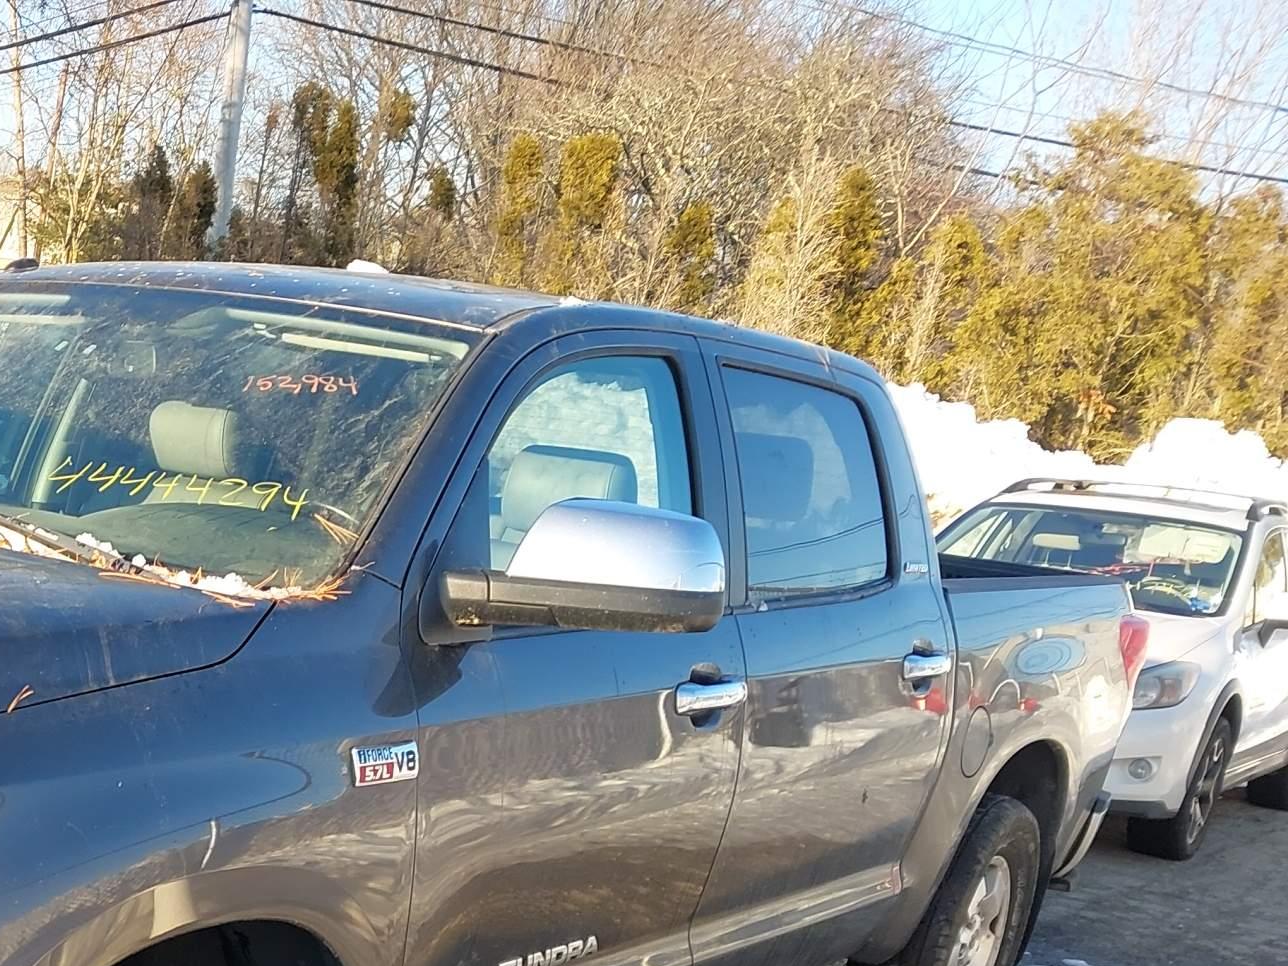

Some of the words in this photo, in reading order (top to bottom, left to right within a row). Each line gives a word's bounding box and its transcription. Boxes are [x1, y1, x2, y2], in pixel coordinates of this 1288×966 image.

[242, 374, 358, 395] 152,984
[48, 456, 309, 521] 44444294
[395, 750, 416, 773] V8
